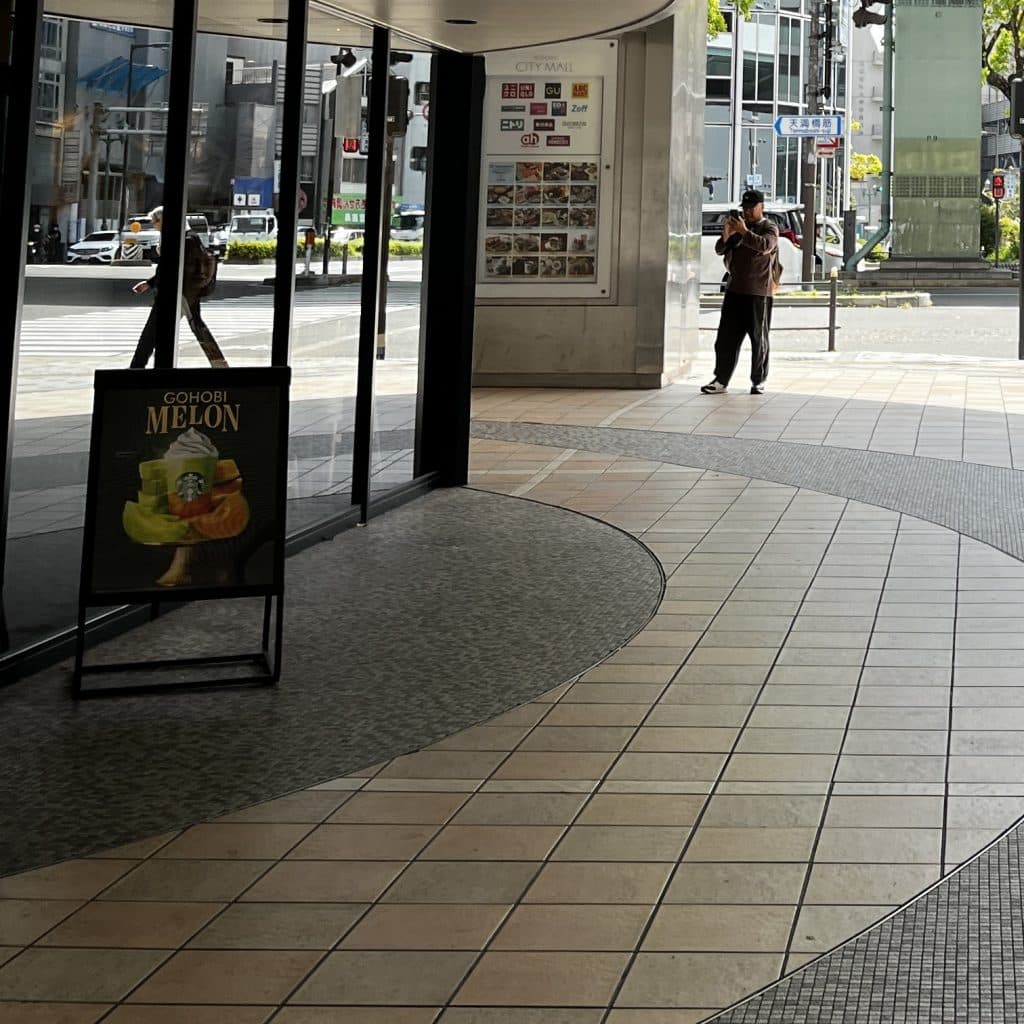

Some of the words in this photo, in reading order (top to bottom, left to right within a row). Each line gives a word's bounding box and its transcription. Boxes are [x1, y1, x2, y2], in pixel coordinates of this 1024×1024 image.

[545, 87, 561, 95] GU
[163, 391, 228, 404] GOHOBI
[145, 403, 241, 434] MELON
